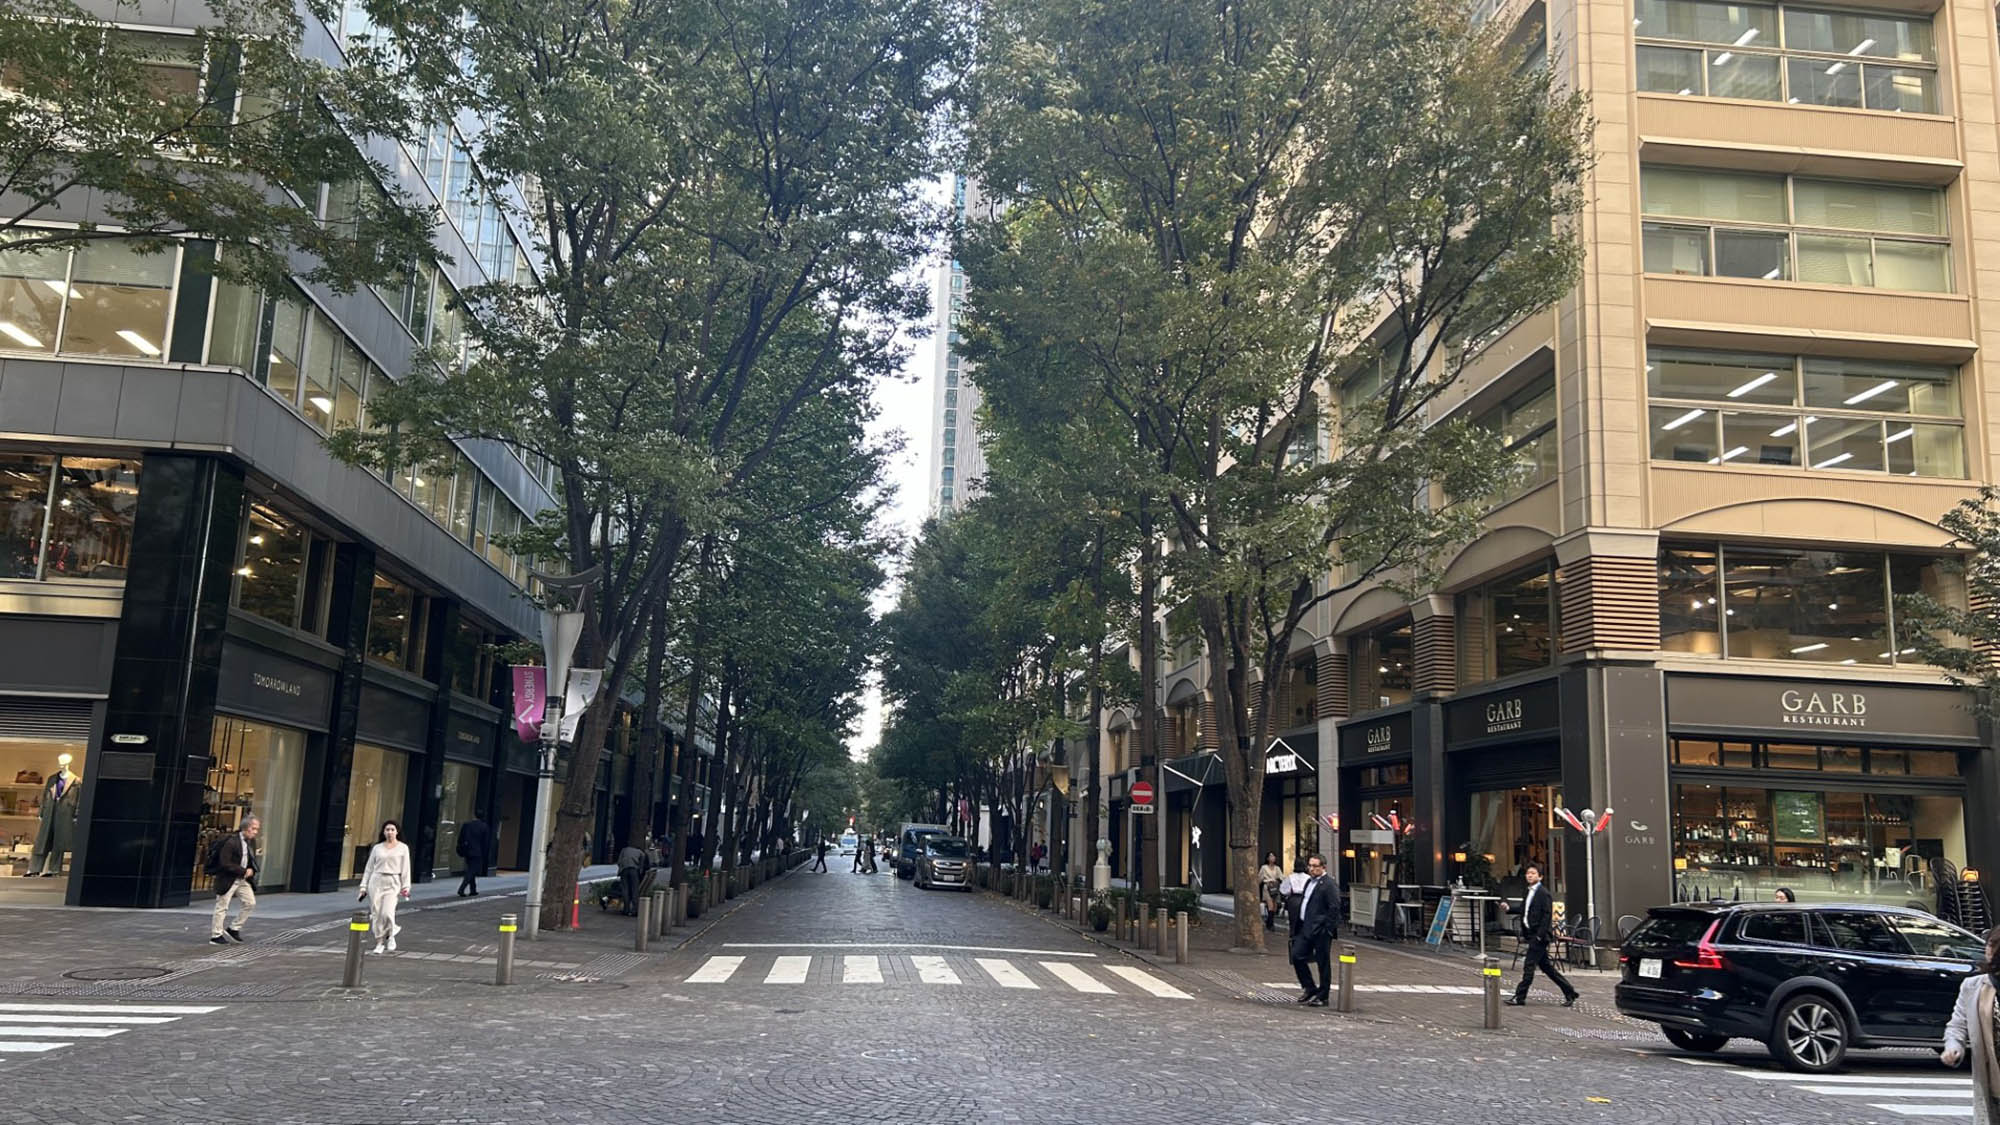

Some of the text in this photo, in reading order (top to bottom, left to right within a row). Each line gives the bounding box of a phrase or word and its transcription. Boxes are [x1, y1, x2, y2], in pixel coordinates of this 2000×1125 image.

[253, 672, 301, 697] TOMORROWLAND
[1486, 698, 1523, 722] GARB
[1781, 689, 1867, 715] GARB
[1487, 720, 1522, 733] RESTAURANT
[1783, 715, 1866, 727] RESTAURANT
[1367, 726, 1391, 744] GARB
